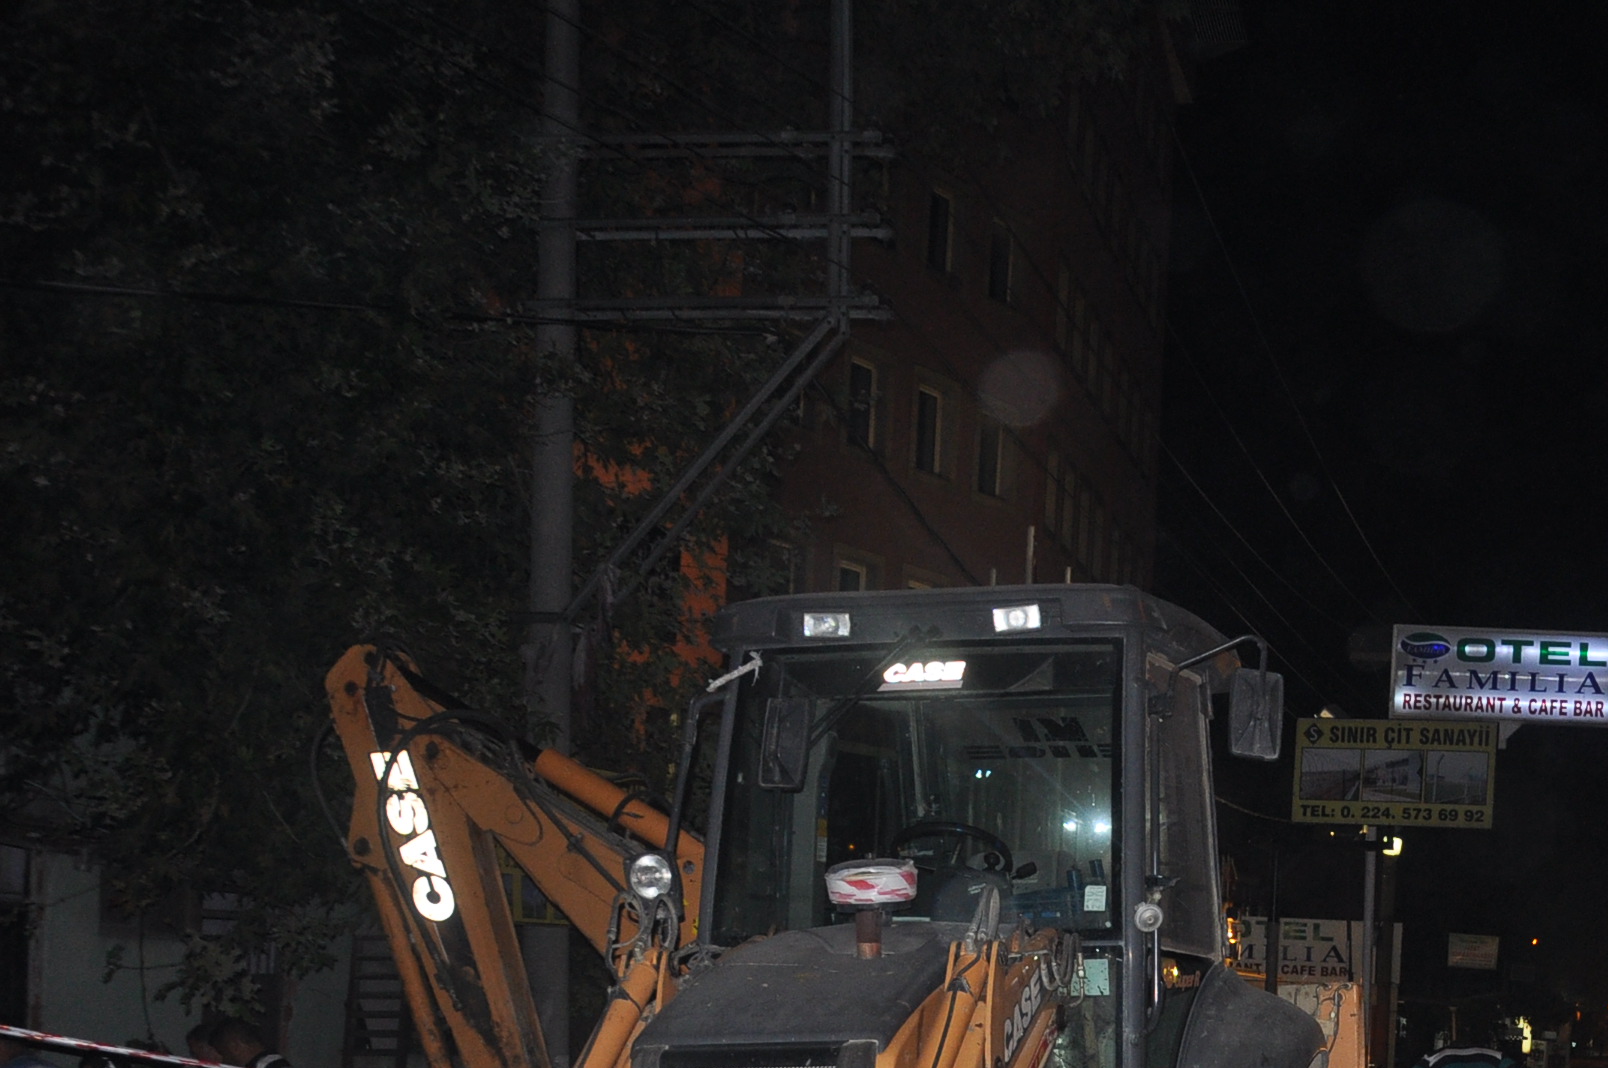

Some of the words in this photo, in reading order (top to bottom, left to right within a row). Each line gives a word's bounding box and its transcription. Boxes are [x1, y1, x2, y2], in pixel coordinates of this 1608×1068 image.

[1456, 637, 1608, 667] OTEL
[883, 660, 967, 683] CASE
[1402, 664, 1605, 695] FAMILIA
[1402, 693, 1506, 714] RESTAURANT
[1511, 702, 1522, 714] &
[1528, 698, 1568, 716] CAFE
[1573, 700, 1605, 718] BAR
[1329, 725, 1377, 744] SINIR
[1384, 723, 1414, 748] ÇİT
[1300, 804, 1335, 818] TEL:
[1361, 806, 1395, 820] 224.
[1402, 807, 1432, 821] 573
[1438, 808, 1458, 822] 69
[1464, 809, 1485, 823] 92
[370, 750, 455, 922] CASE
[1281, 964, 1316, 976] CAFE
[1321, 965, 1347, 977] BAR
[1003, 967, 1042, 1063] CASE
